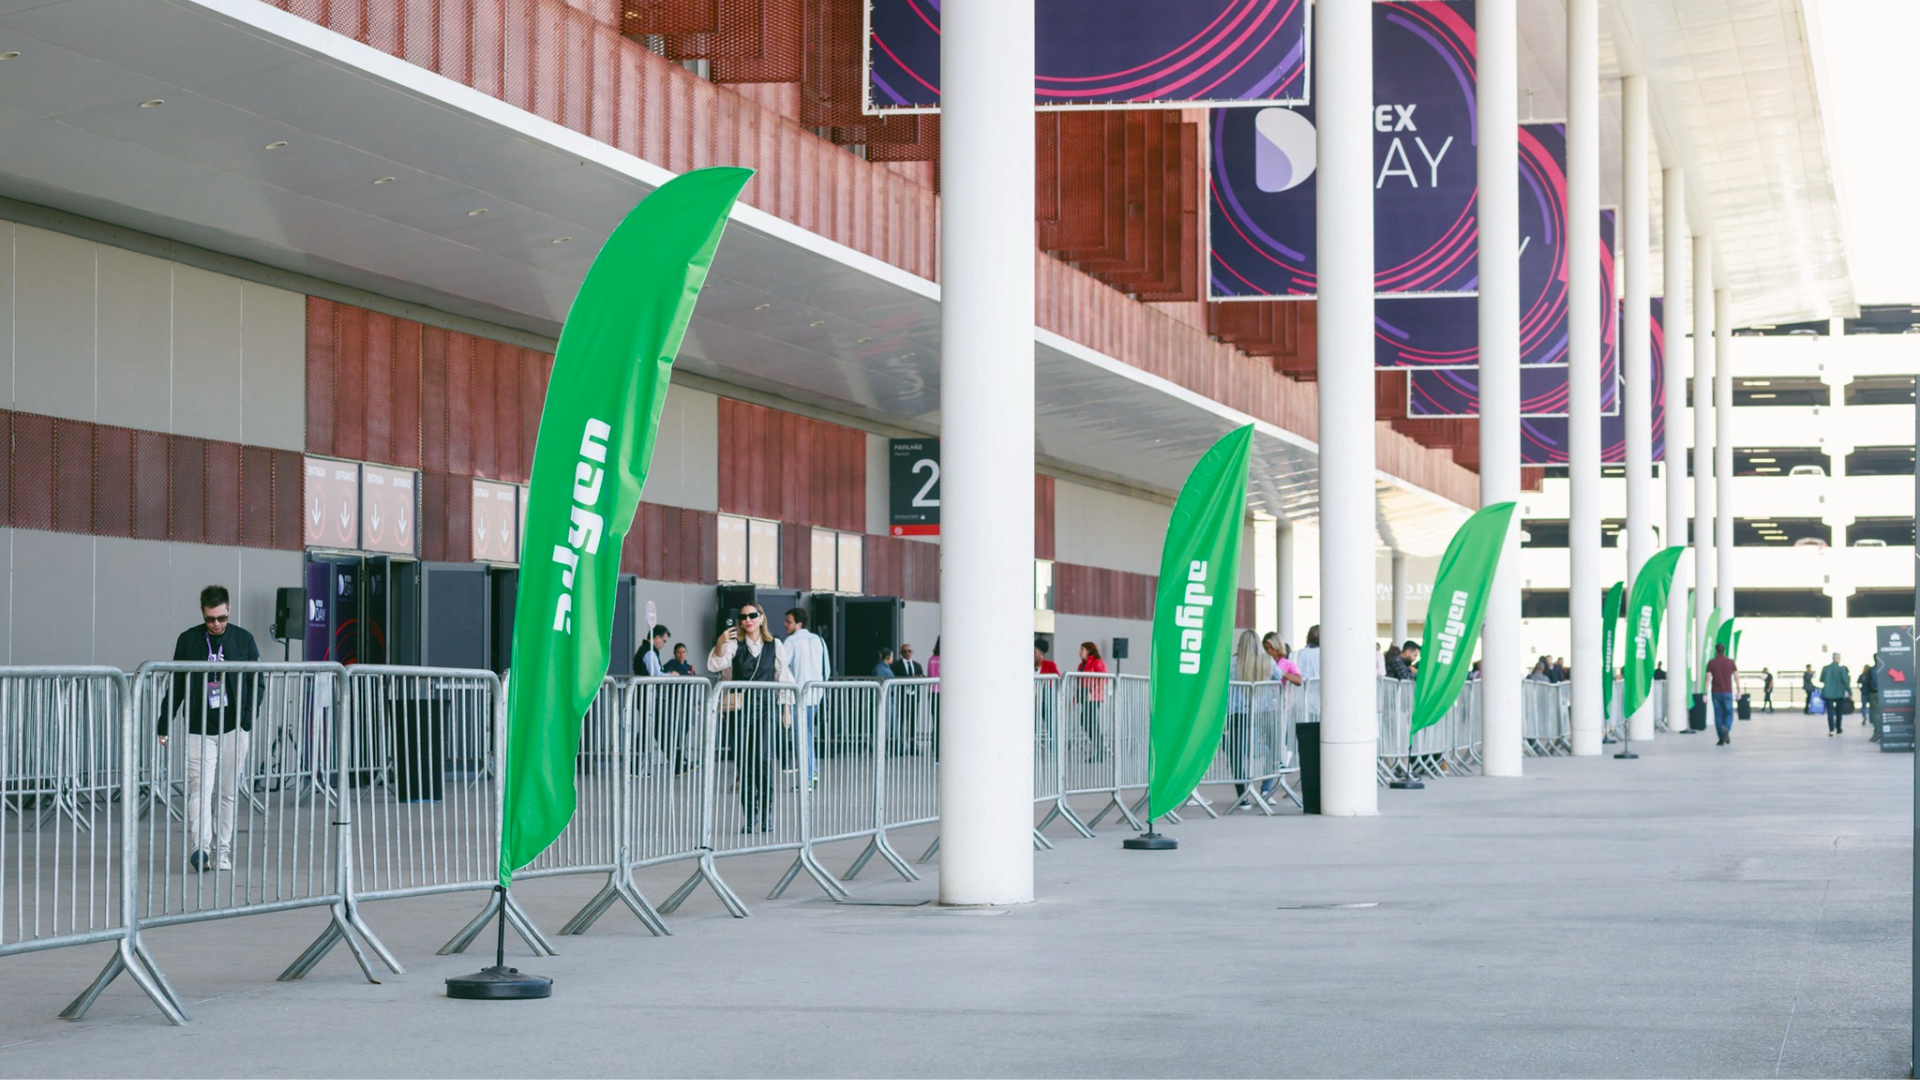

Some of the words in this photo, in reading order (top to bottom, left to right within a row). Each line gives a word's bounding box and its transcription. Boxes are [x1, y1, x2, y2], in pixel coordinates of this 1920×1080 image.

[1372, 104, 1417, 131] EX
[1376, 136, 1453, 189] AY
[912, 458, 940, 507] 2
[1175, 560, 1213, 674] adyen
[1437, 590, 1468, 665] adyen
